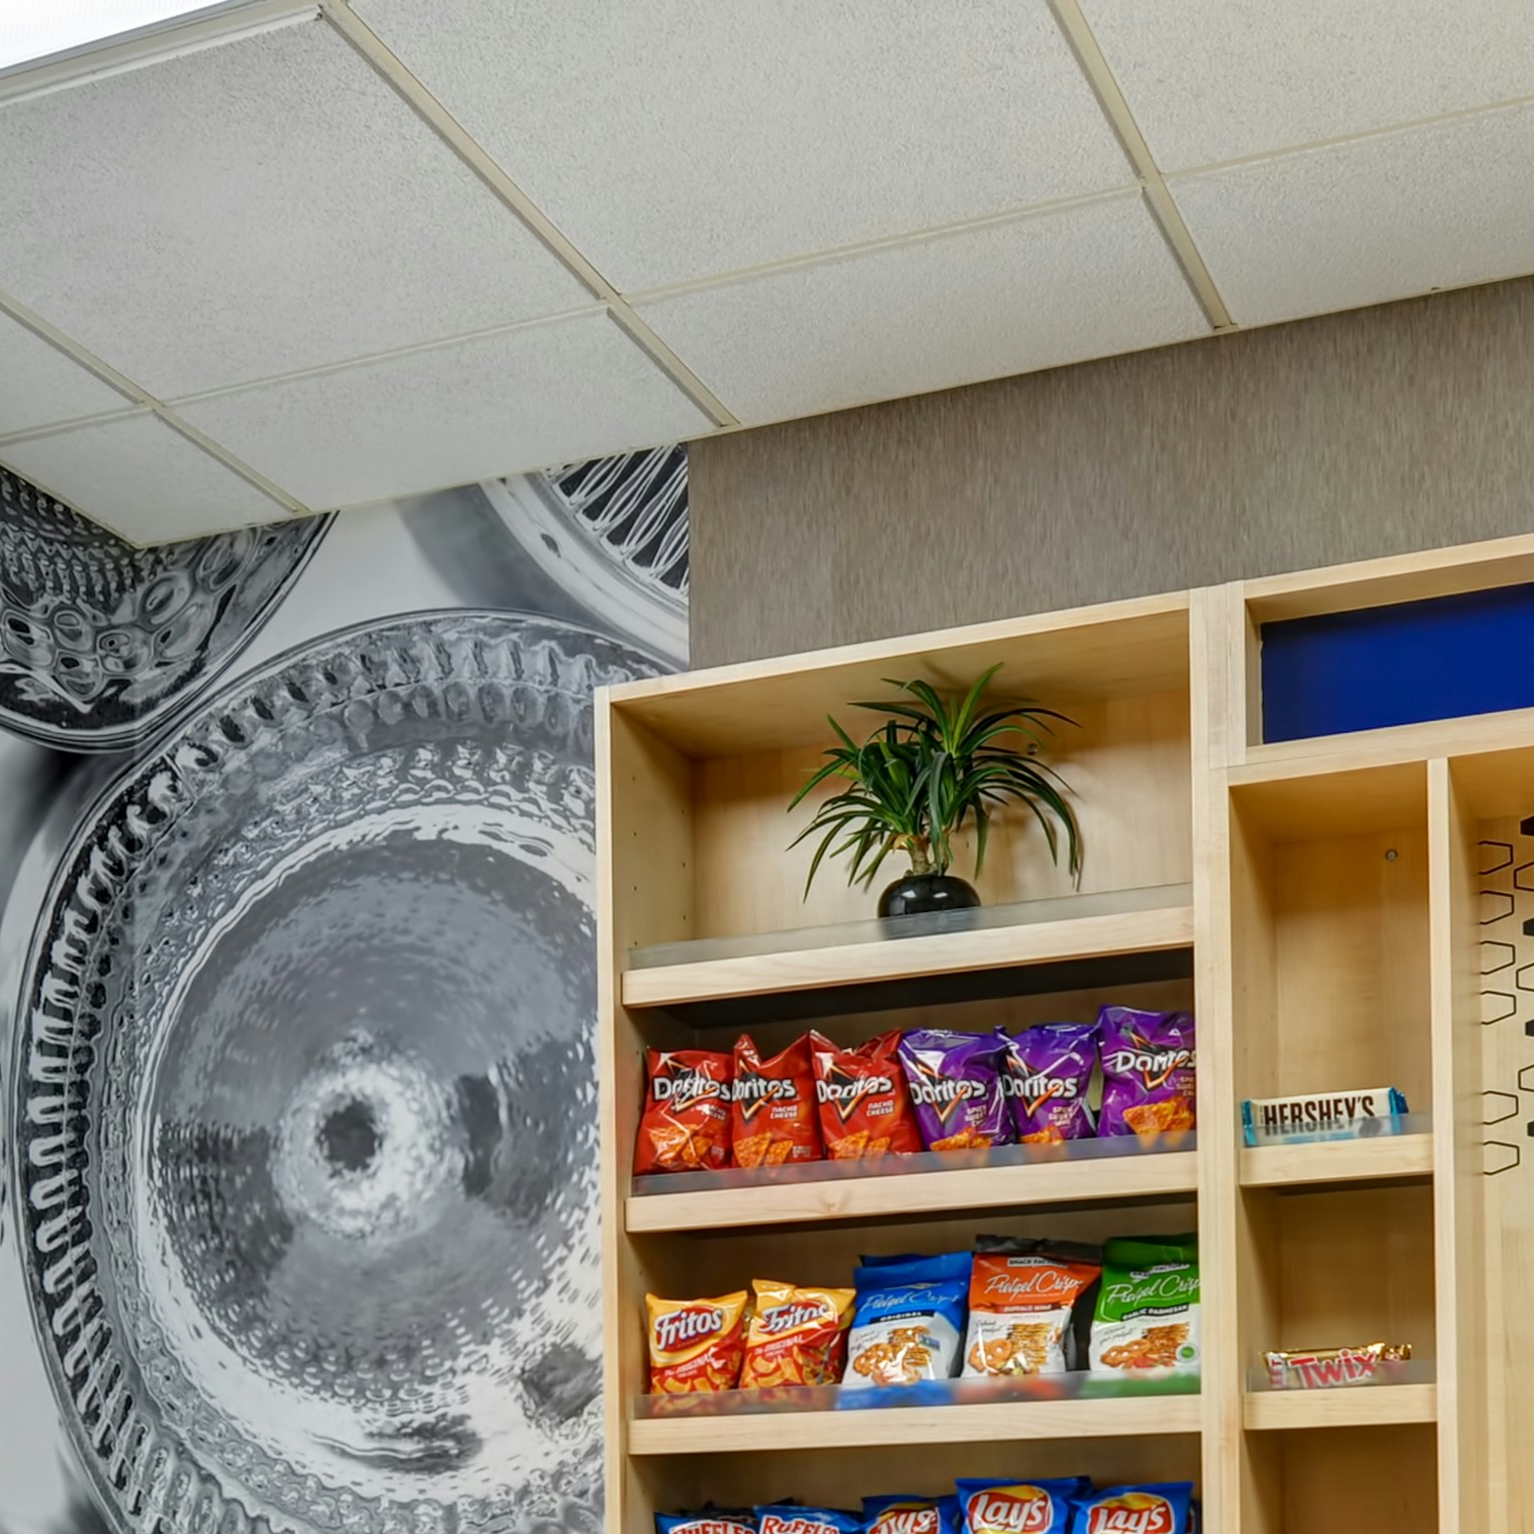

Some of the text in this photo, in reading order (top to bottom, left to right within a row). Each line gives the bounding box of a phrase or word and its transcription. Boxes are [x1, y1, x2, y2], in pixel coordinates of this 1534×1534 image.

[817, 1076, 893, 1104] Doritos
[908, 1078, 987, 1106] Doritos
[1003, 1073, 1078, 1098] Doritos
[1264, 1096, 1375, 1135] HERSHEY'S
[1159, 1274, 1200, 1297] Crisp
[655, 1307, 723, 1350] Fritos
[1288, 1348, 1377, 1389] Twix
[973, 1495, 1049, 1534] Lay's
